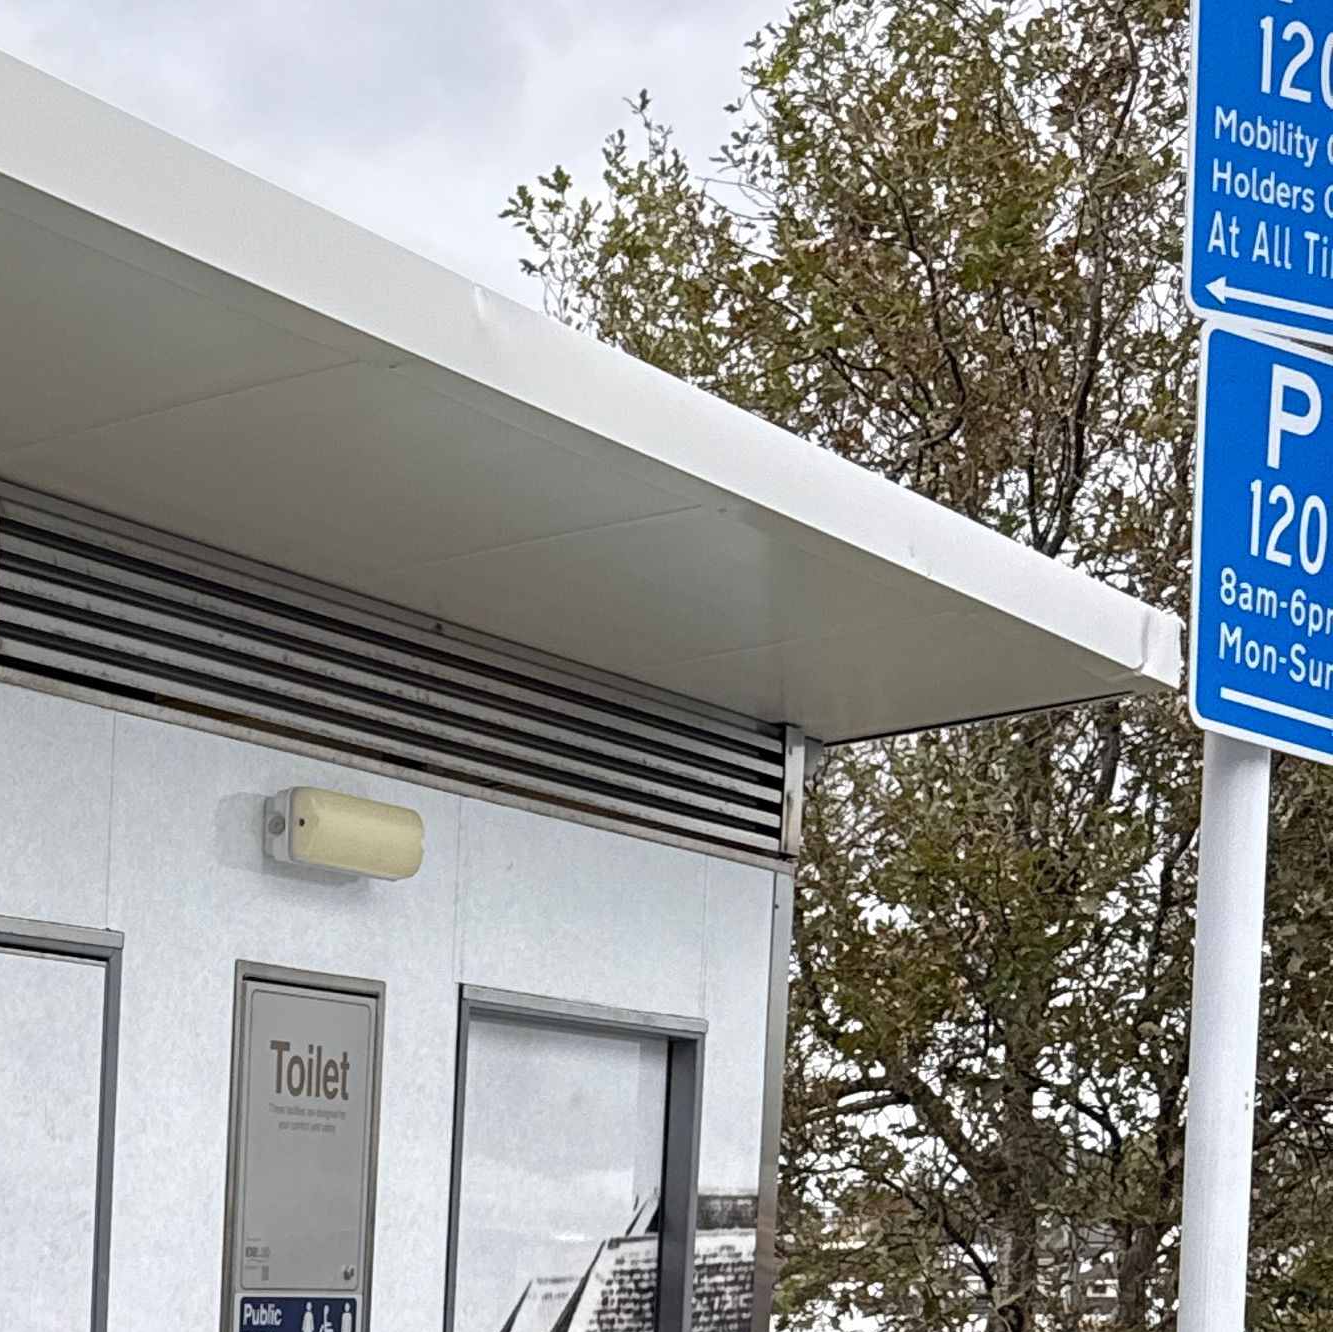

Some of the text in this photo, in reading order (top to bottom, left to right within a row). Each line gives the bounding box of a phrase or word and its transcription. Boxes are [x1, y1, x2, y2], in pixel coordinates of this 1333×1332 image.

[1215, 105, 1319, 168] Mobility
[1212, 158, 1315, 214] Holders
[1207, 210, 1240, 259] At
[1252, 221, 1292, 270] All
[1267, 363, 1322, 470] P
[1250, 479, 1328, 575] 120
[269, 1039, 350, 1101] Toilet
[243, 1302, 282, 1326] Public
